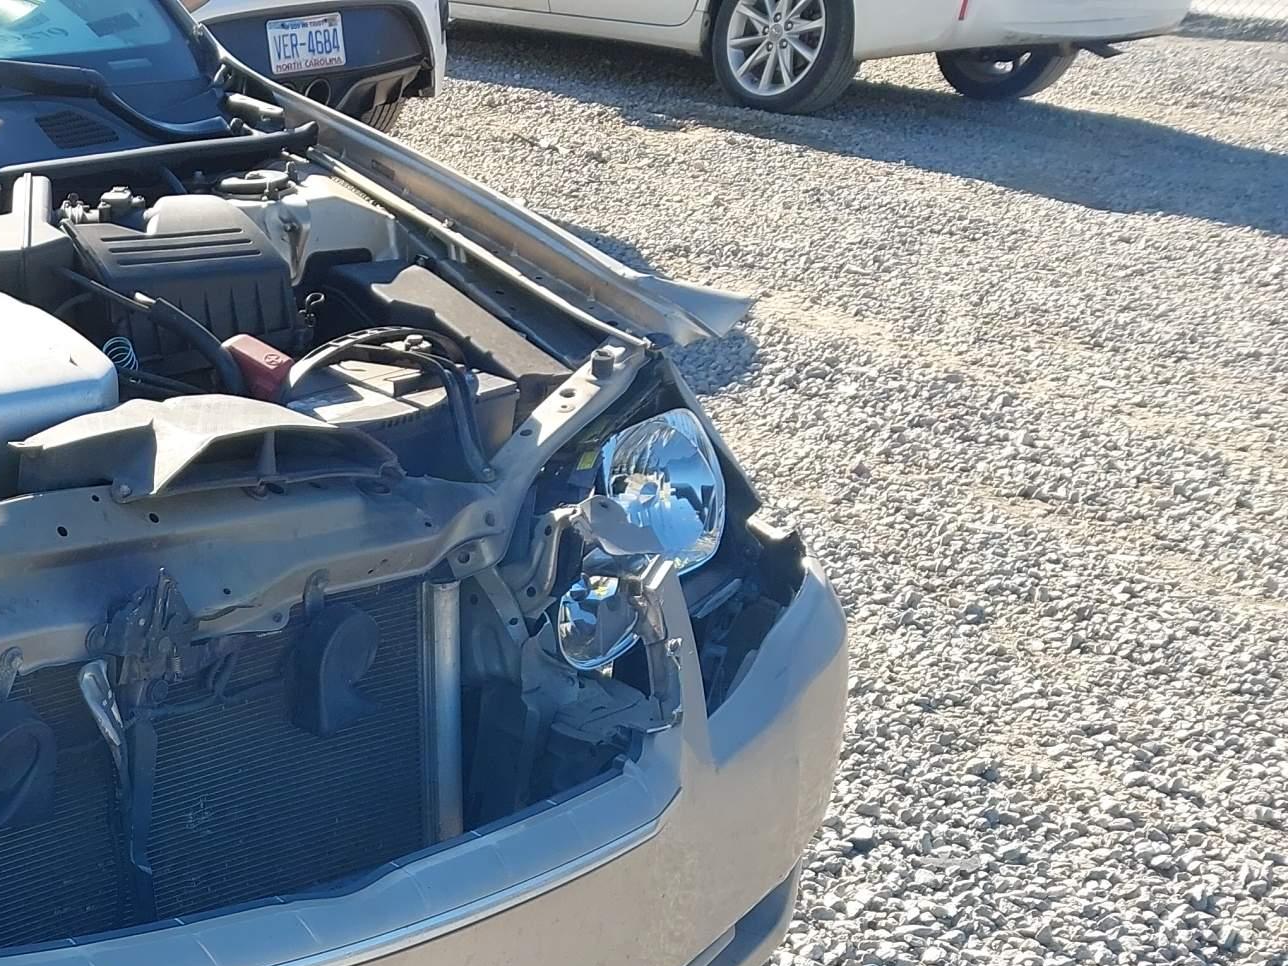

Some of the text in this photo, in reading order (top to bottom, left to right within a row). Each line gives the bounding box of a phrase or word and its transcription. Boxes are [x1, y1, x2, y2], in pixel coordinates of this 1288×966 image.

[273, 28, 340, 60] VER-4684
[276, 56, 343, 72] NORTH CAROLINA
